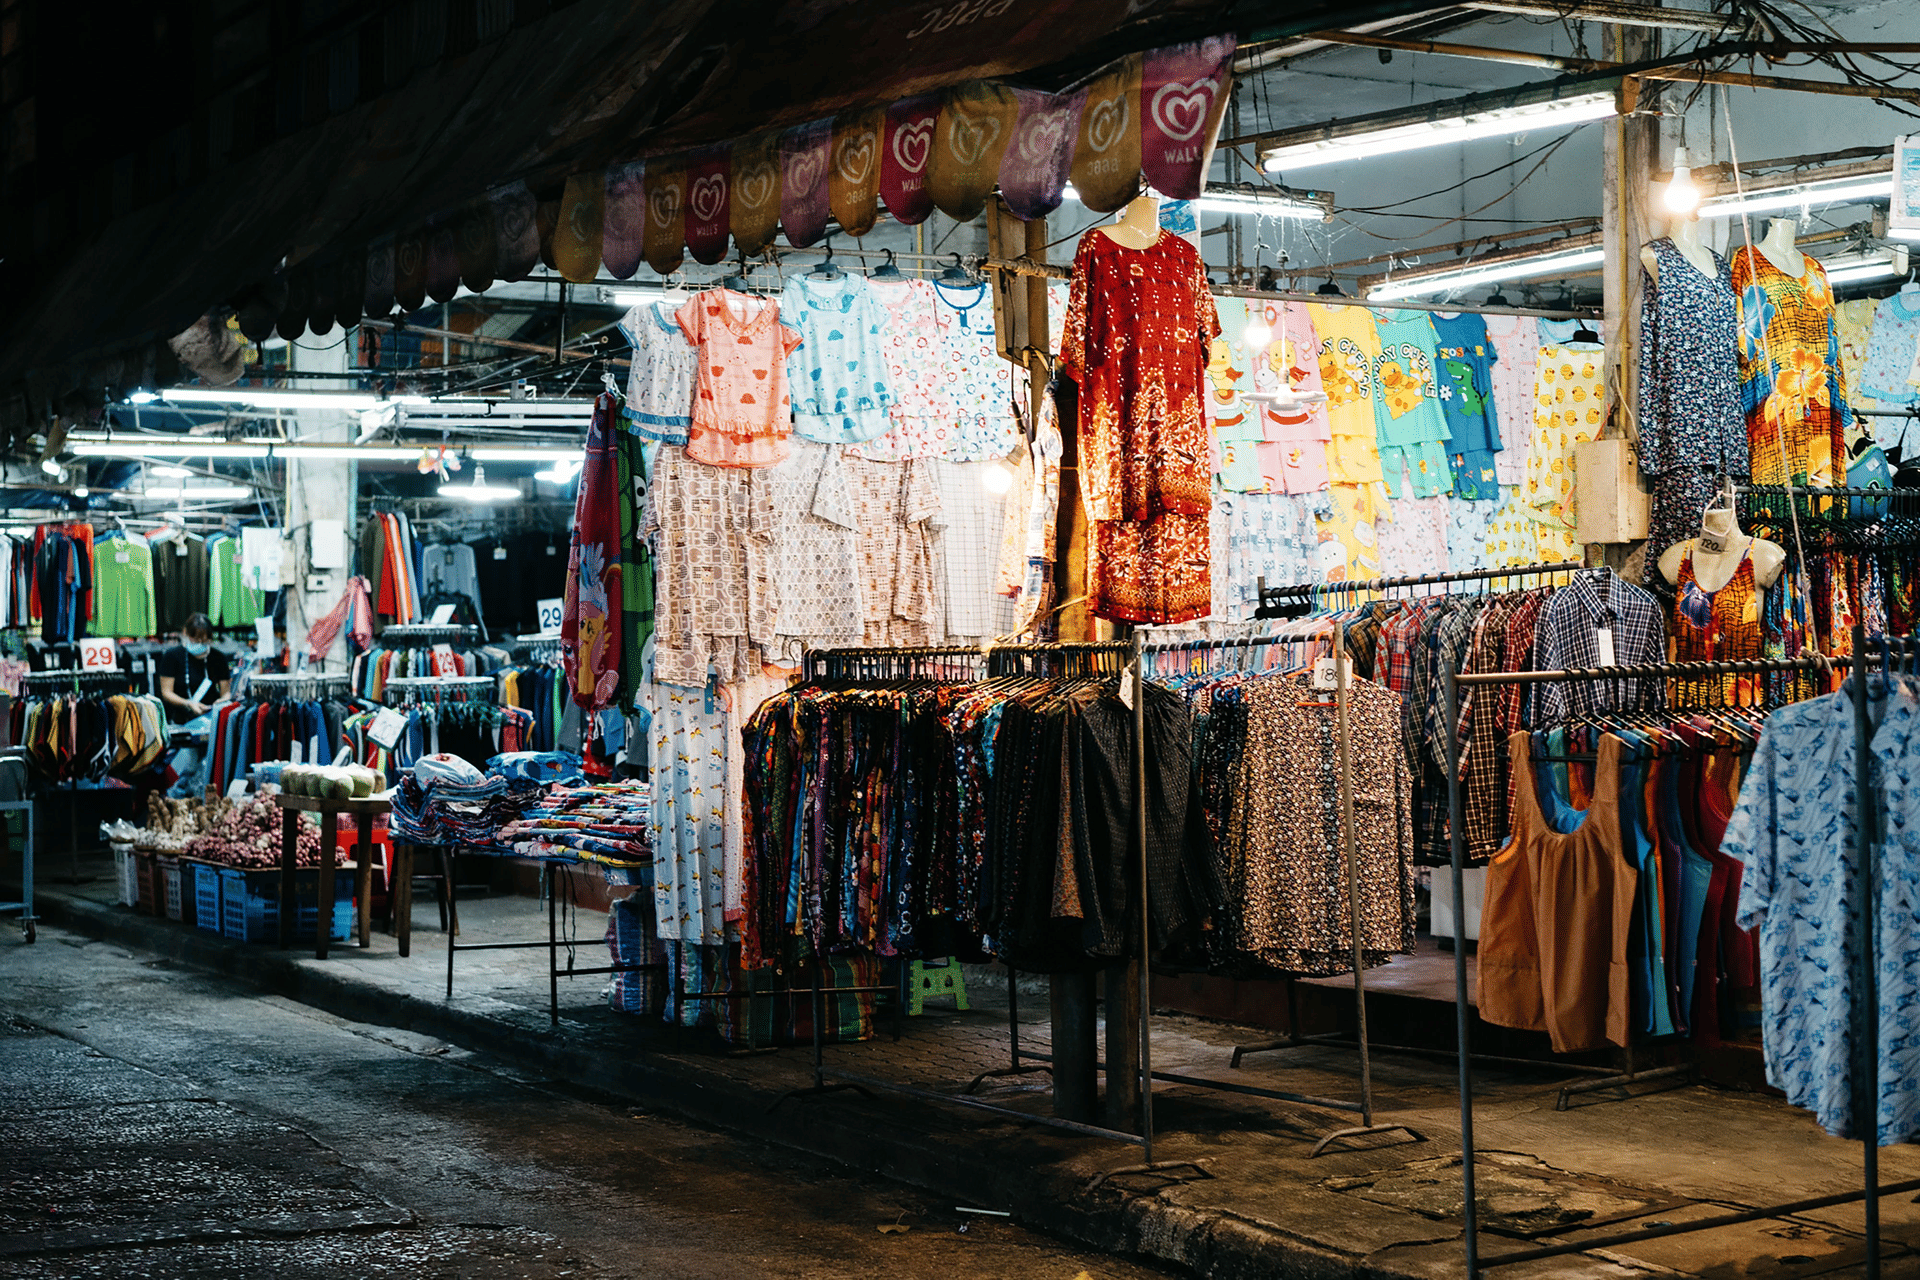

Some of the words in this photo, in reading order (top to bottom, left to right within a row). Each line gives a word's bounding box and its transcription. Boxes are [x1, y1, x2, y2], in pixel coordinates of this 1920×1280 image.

[905, 0, 1016, 39] วอลล
[541, 607, 562, 628] 29
[85, 646, 113, 666] 29
[438, 652, 455, 672] 29
